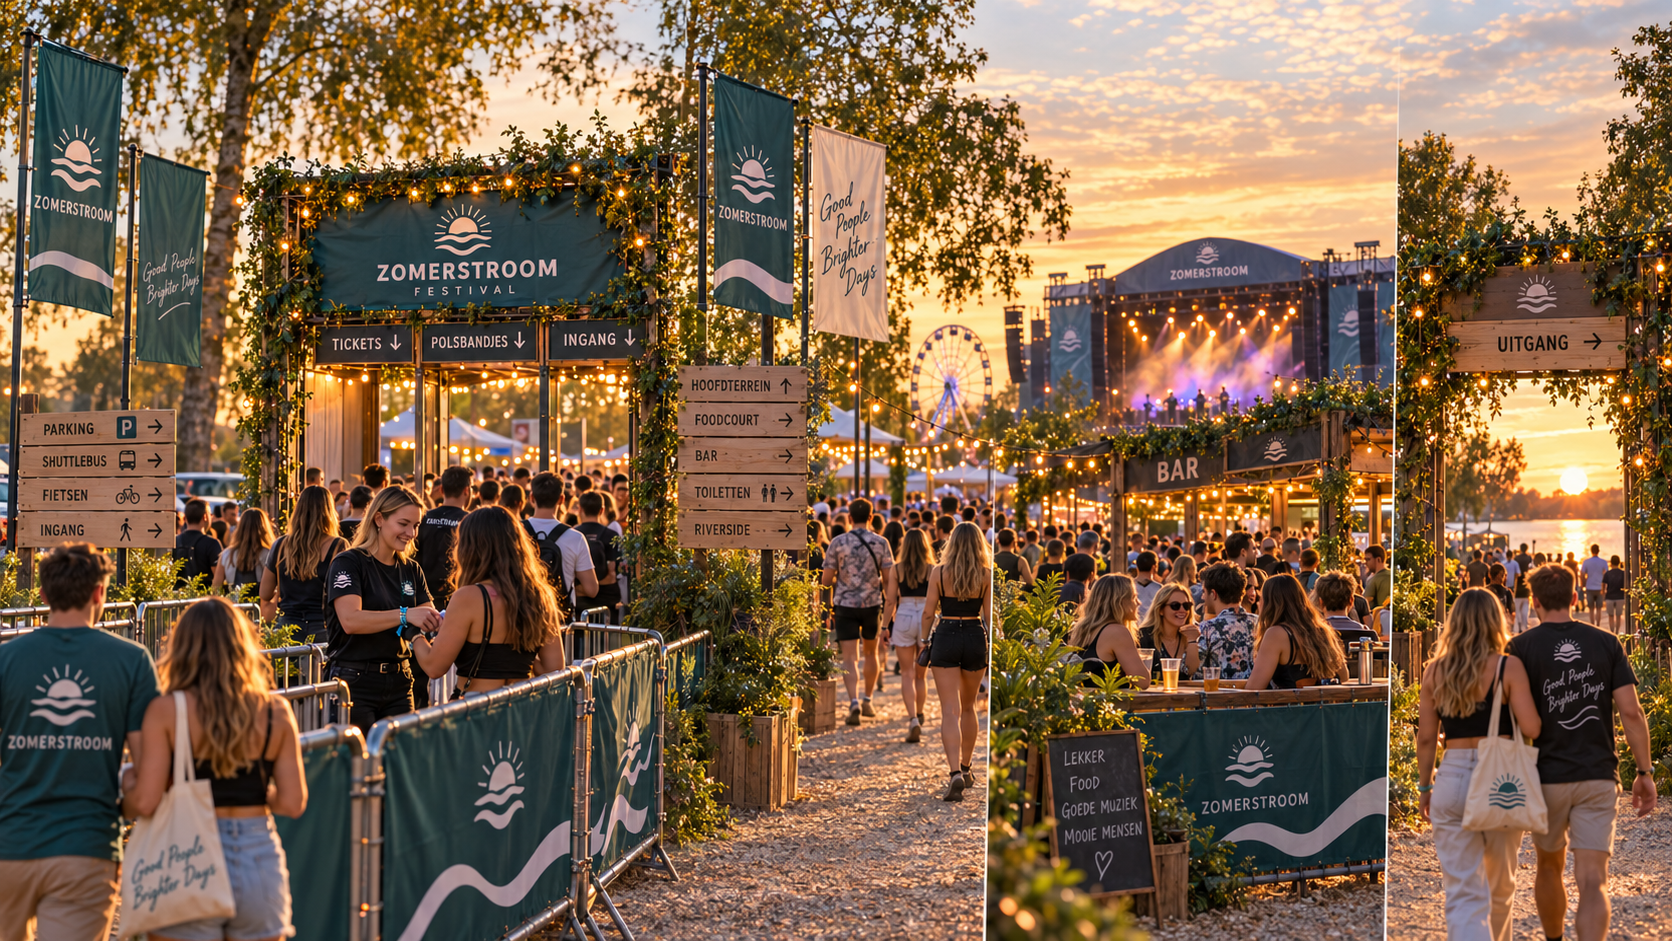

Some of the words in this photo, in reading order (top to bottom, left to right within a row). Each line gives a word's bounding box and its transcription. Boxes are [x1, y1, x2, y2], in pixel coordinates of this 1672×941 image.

[34, 194, 114, 224] ZOMERSTROOM
[820, 181, 854, 223] Good
[719, 205, 787, 231] ZOMERSTROOM
[835, 201, 871, 240] People
[143, 254, 169, 284] Good
[171, 247, 197, 272] People
[821, 236, 870, 279] Brighter
[377, 258, 558, 282] ZOMERSTROOM
[1170, 264, 1249, 281] ZOMERSTROOM
[844, 264, 877, 297] Days
[147, 280, 180, 308] Brighter
[181, 274, 200, 297] Days
[414, 284, 516, 297] FESTIVAL
[332, 337, 382, 351] TICKETS
[431, 335, 508, 349] POLSBANDJES
[564, 333, 616, 347] INGANG
[1497, 334, 1569, 352] UITGANG
[691, 379, 771, 392] HOOFDTERREIN
[43, 422, 94, 436] PARKING
[695, 413, 760, 426] FOODCOURT
[42, 454, 107, 468] SHUTTLEBUS
[695, 449, 718, 462] BAR
[1157, 456, 1199, 483] BAR
[42, 488, 88, 502] FIETSEN
[694, 486, 751, 499] TOILETTEN
[40, 524, 85, 537] INGANG
[694, 523, 751, 536] RIVERSIDE
[1543, 671, 1566, 696] Good
[1568, 663, 1595, 685] People
[1547, 690, 1580, 713] Brighter
[1582, 682, 1605, 701] Days
[8, 734, 112, 751] ZOMERSTROOM
[1064, 749, 1106, 767] LEKKER
[1069, 775, 1100, 794] FOOD
[1061, 801, 1096, 820] GOEDE
[1100, 796, 1138, 814] MUZIEK
[1201, 791, 1309, 815] ZOMERSTROOM
[1064, 827, 1097, 845] MOOIE
[1101, 821, 1143, 840] MENSEN
[131, 850, 165, 885] Good
[168, 835, 205, 867] People
[132, 875, 180, 912] Brighter
[183, 863, 216, 890] Days
